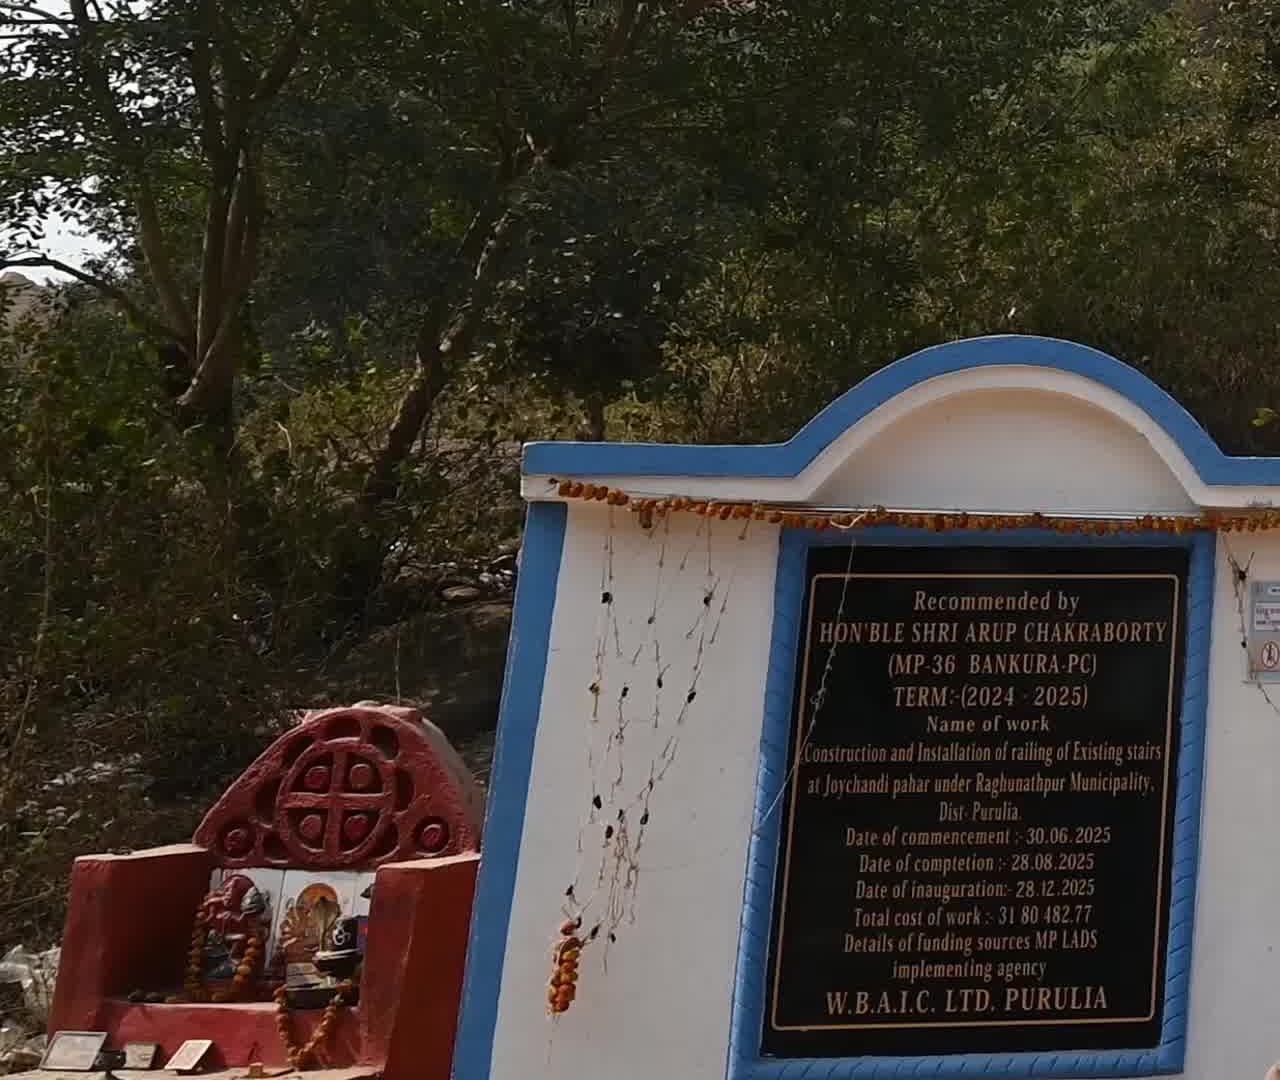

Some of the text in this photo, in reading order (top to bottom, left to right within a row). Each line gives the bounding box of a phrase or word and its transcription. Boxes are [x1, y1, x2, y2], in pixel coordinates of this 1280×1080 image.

[914, 591, 1080, 615] Recommended by
[819, 622, 1167, 643] HON'BLE SHRI ARUP CHAKRABORTY
[1034, 686, 1088, 707] 2025)
[927, 715, 1049, 733] Name of work
[890, 743, 914, 761] and
[917, 742, 991, 761] Installation
[995, 742, 1008, 761] of
[1011, 742, 1053, 765] railing
[1057, 742, 1069, 761] of
[1074, 741, 1123, 766] Existing
[1128, 741, 1161, 760] stairs
[808, 776, 821, 793] at
[824, 774, 888, 798] Joychandi
[893, 774, 929, 797] pahar
[935, 774, 970, 793] under
[976, 774, 1065, 796] Raghunathpur
[846, 828, 879, 846] Date
[883, 828, 899, 846] of
[902, 827, 1009, 845] commencement
[1027, 827, 1111, 844] 30.06.2025
[859, 855, 891, 872] Date
[895, 855, 911, 872] of
[1012, 853, 1094, 871] 28.08.2025
[856, 880, 888, 899] Date
[892, 880, 908, 899] of
[1016, 879, 1094, 897] 28.12.2025
[855, 908, 888, 927] Total
[894, 908, 924, 926] cost
[928, 908, 942, 926] of
[947, 908, 980, 926] work
[844, 929, 1097, 955] Details of funding sources MP LADS
[893, 959, 1046, 982] implementing agency
[826, 990, 935, 1015] W.B.A.I.C.
[1005, 986, 1107, 1010] PURULIA
